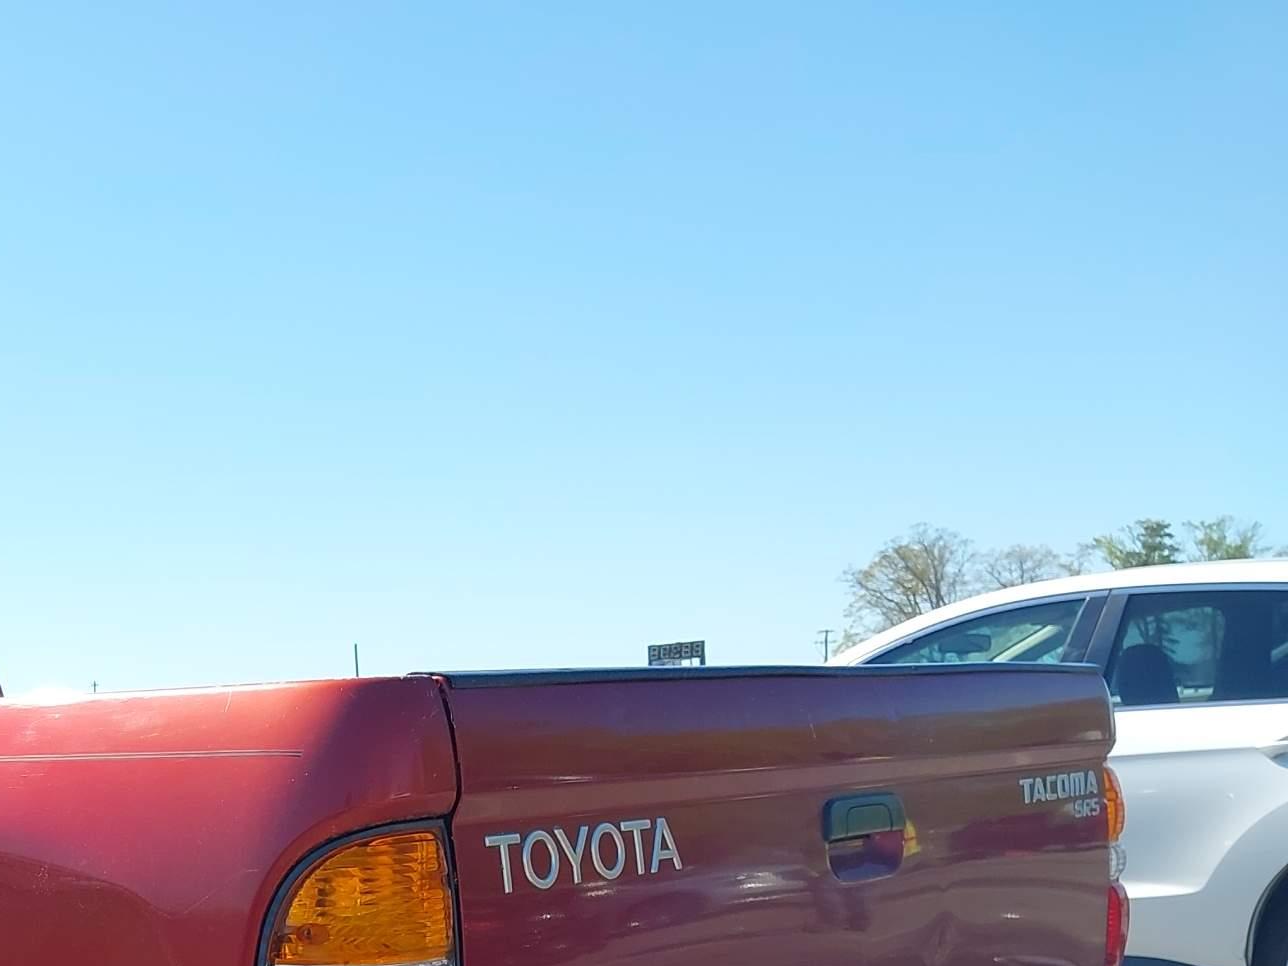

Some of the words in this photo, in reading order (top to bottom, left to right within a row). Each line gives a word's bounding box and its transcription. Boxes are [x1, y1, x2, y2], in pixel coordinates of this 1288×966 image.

[1019, 770, 1098, 804] TACOMA
[1074, 798, 1100, 818] SR5
[484, 817, 683, 894] TOYOTA
